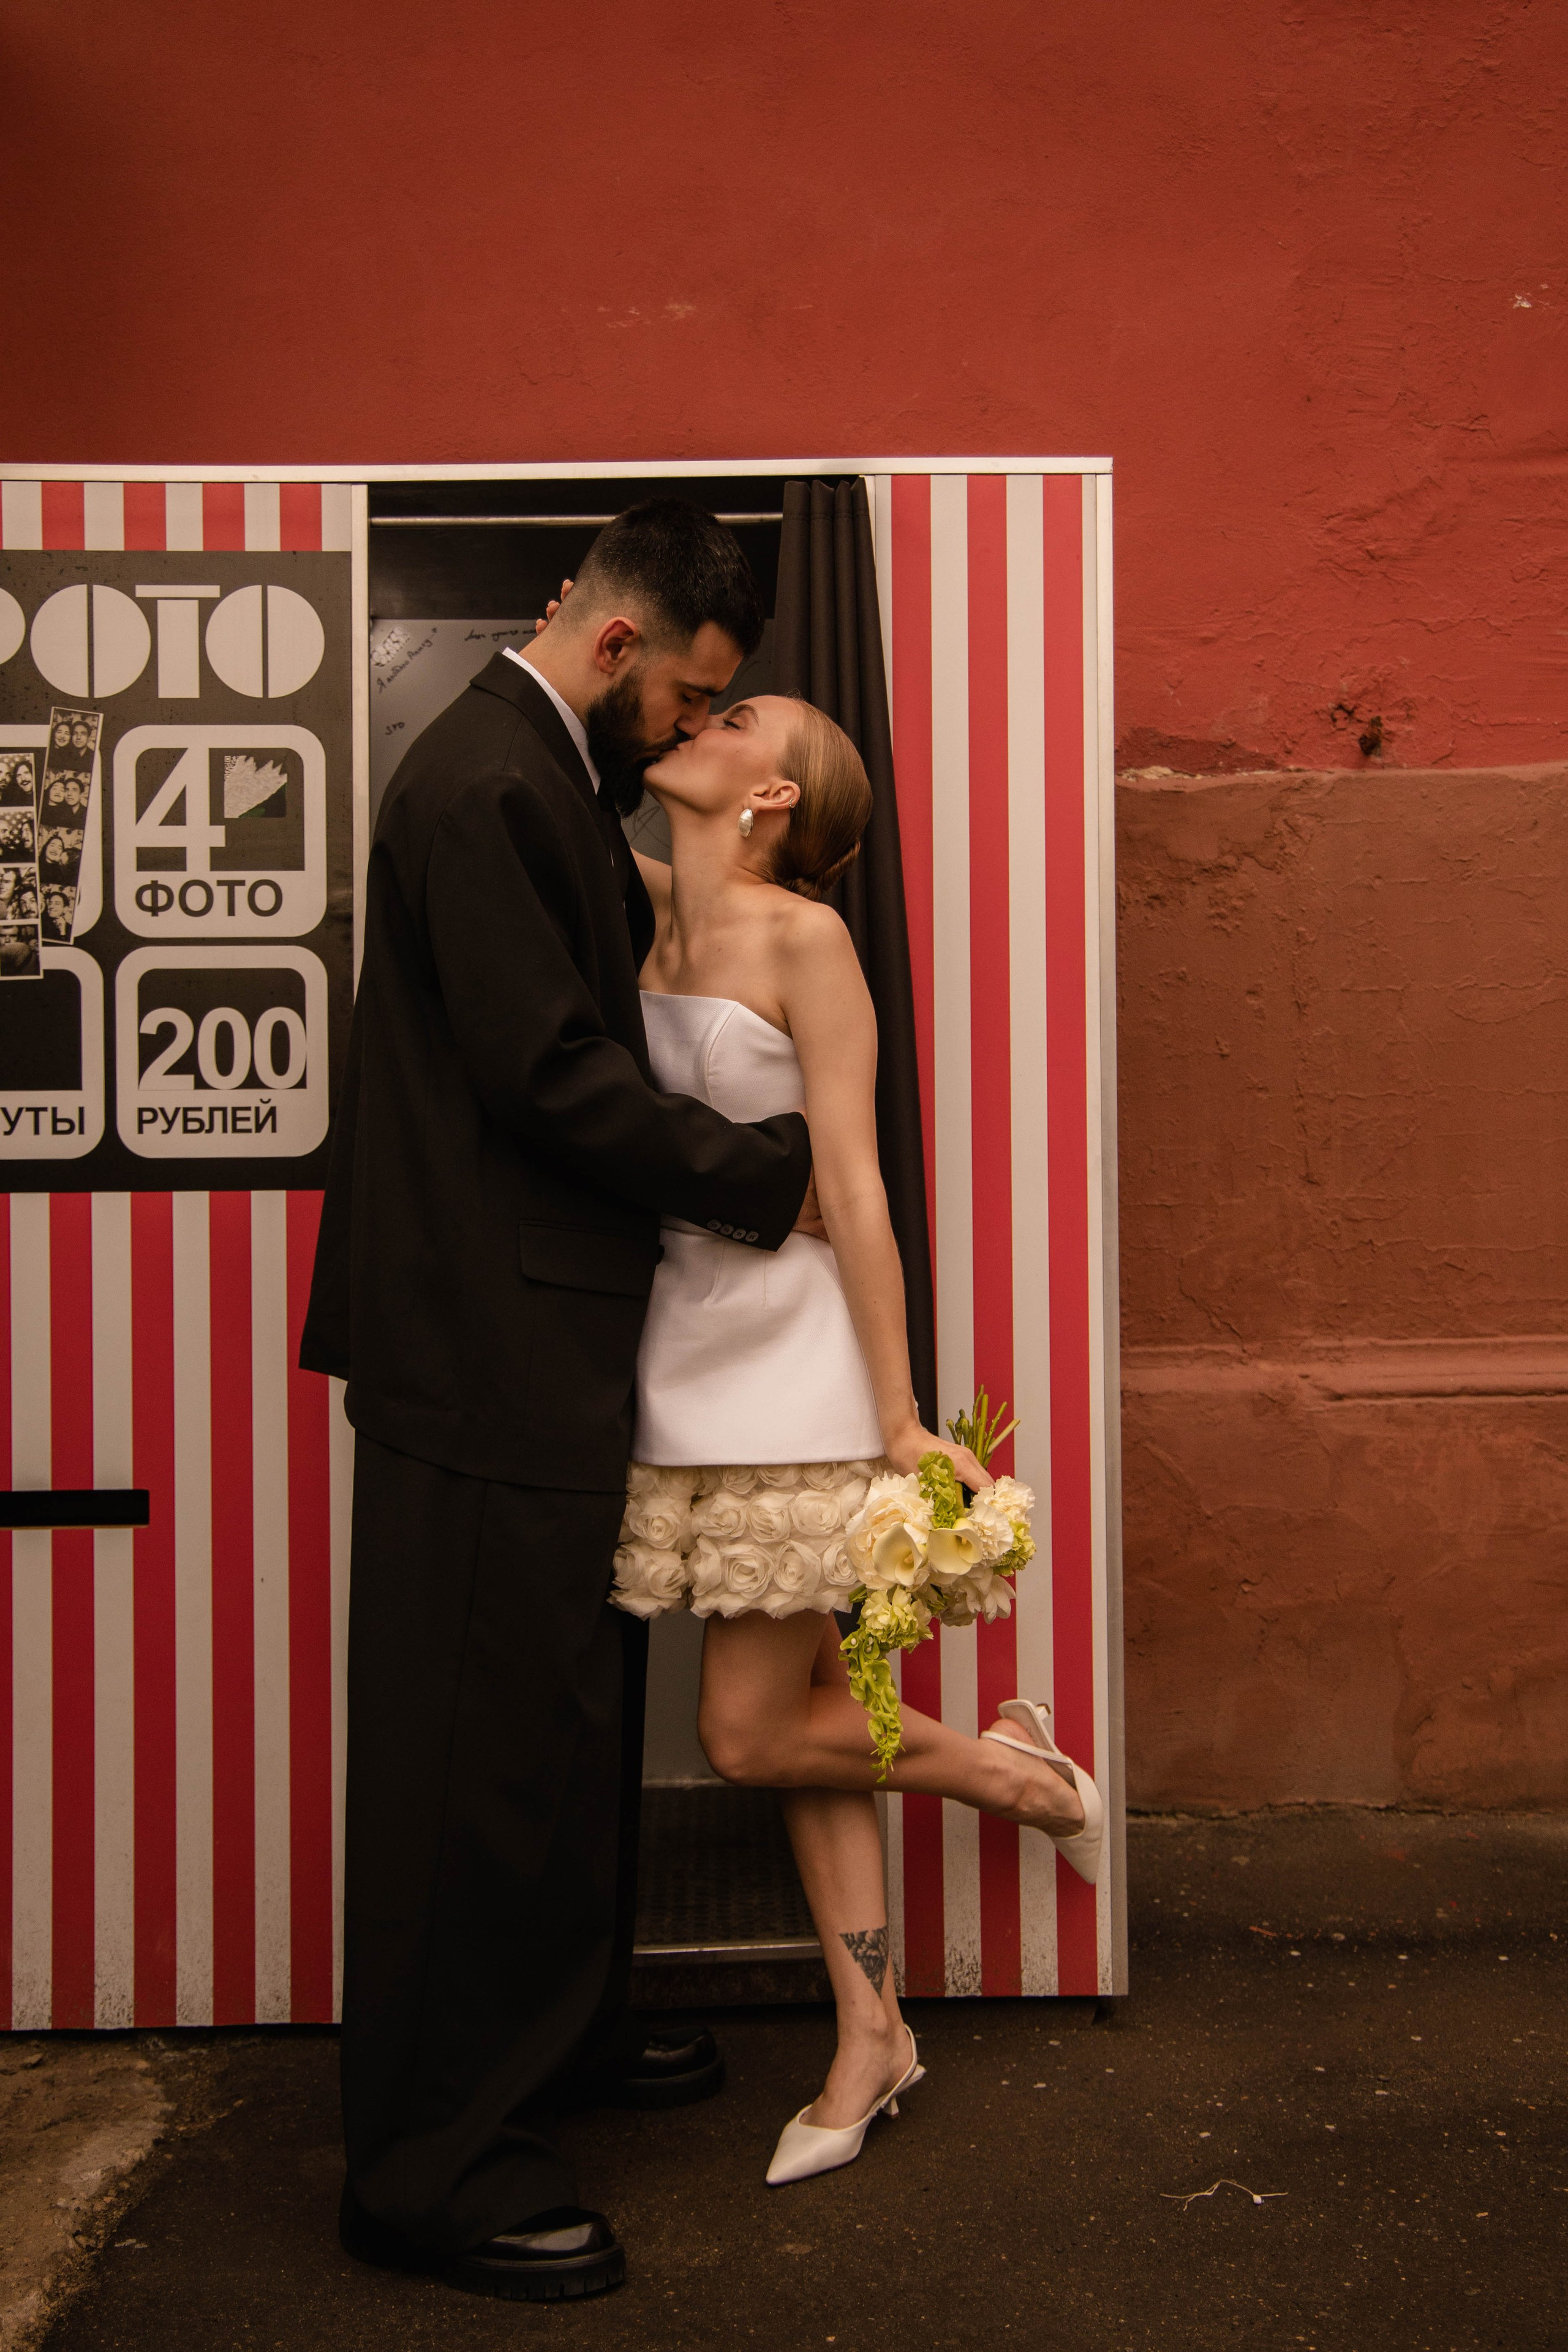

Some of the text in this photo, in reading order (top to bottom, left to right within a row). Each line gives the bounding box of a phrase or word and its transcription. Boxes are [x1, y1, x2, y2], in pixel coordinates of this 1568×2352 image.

[135, 747, 225, 871] 4
[135, 879, 284, 918] ФОТО
[139, 1006, 307, 1090] 200
[137, 1098, 277, 1135] РУБЛЕЙ
